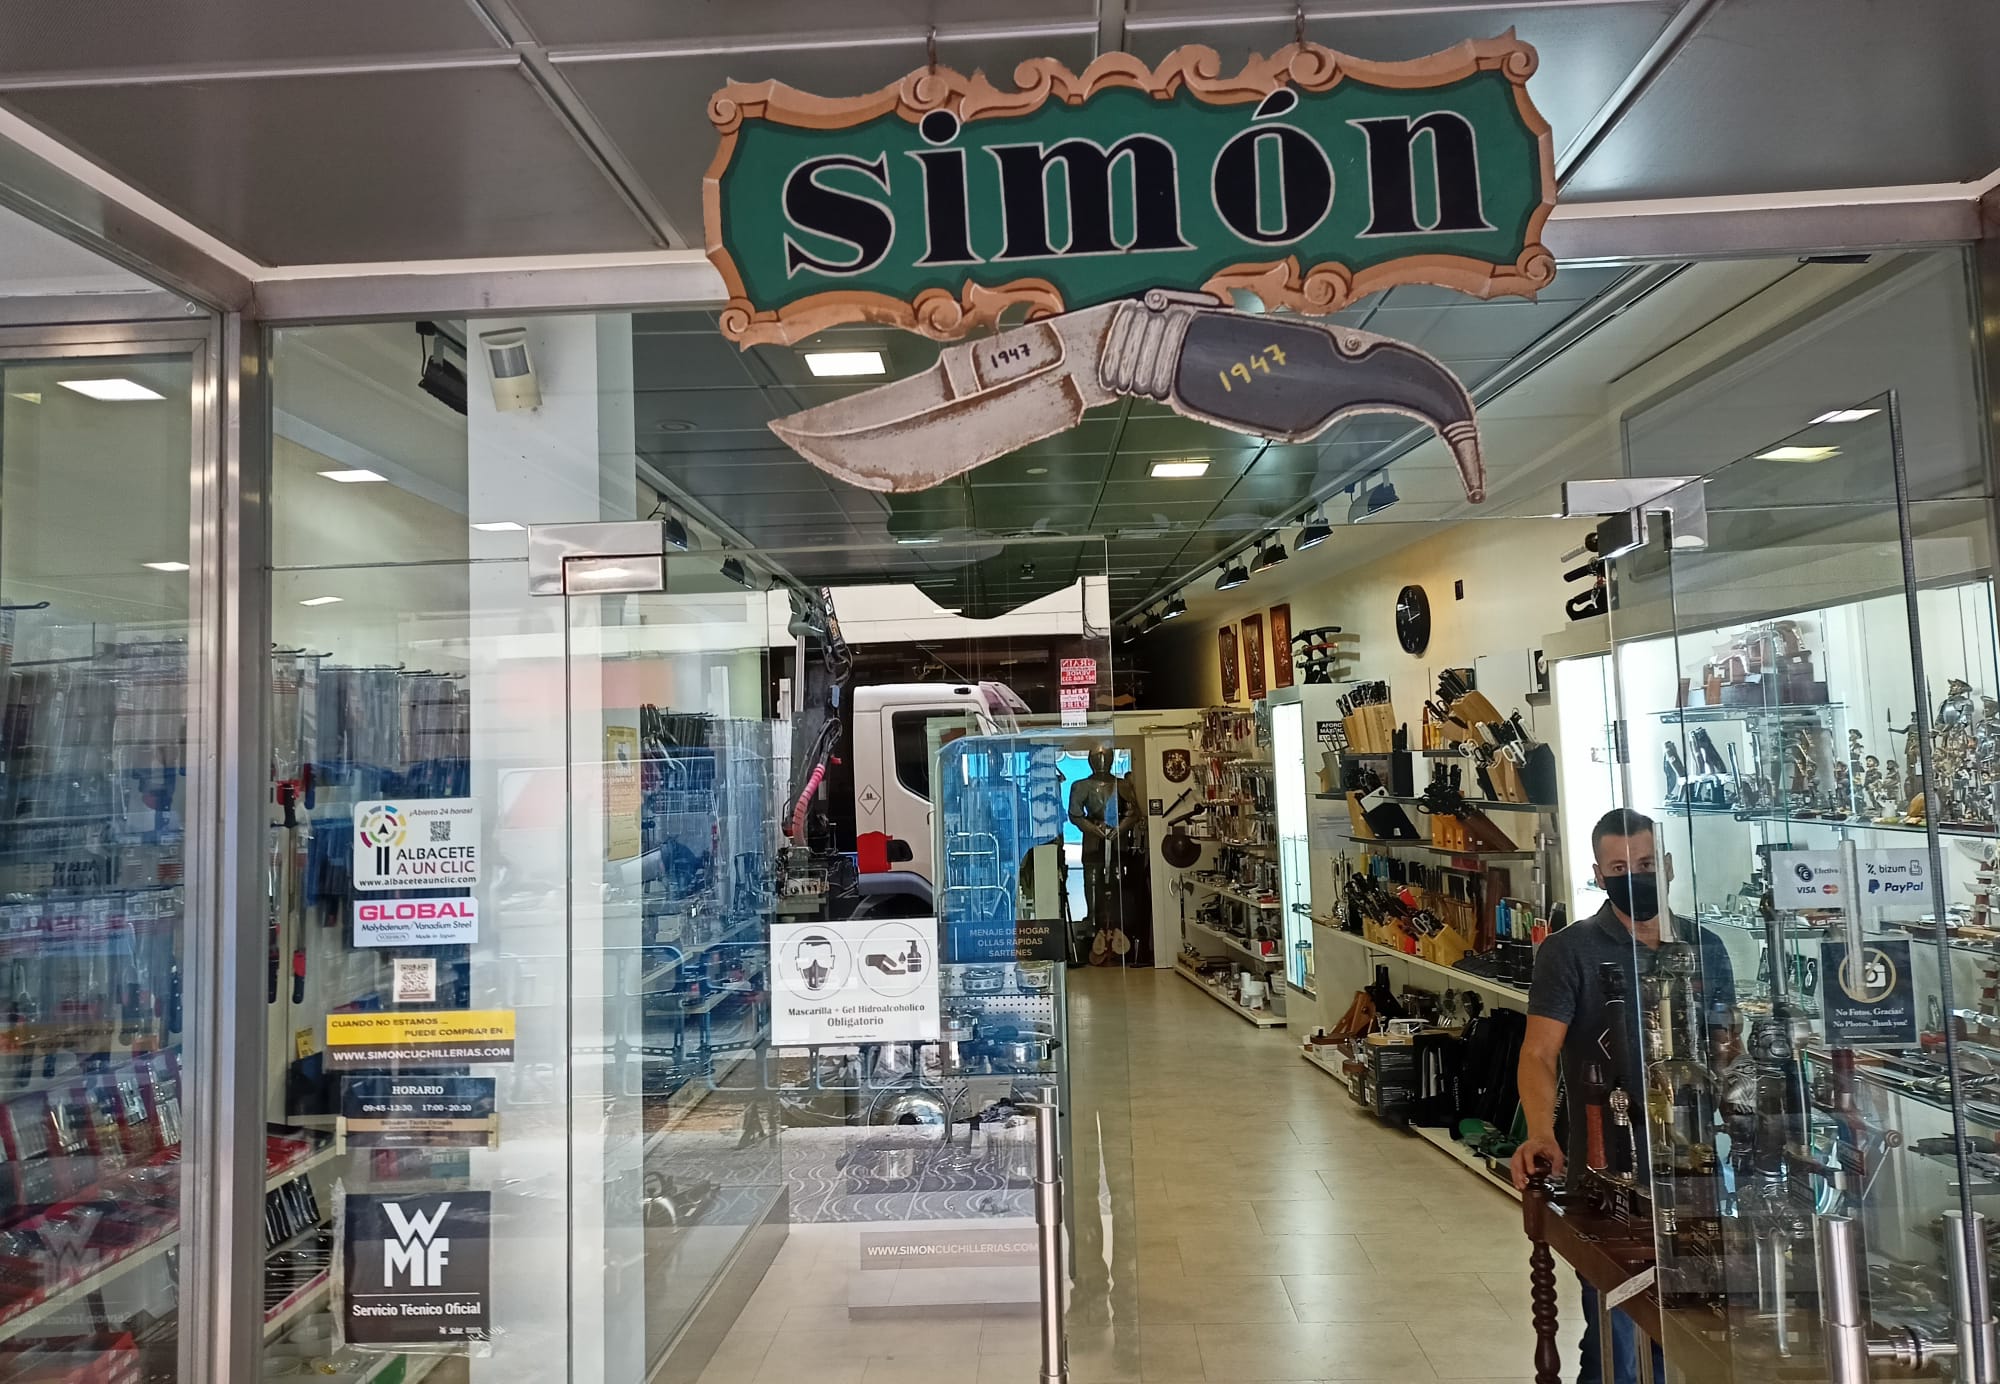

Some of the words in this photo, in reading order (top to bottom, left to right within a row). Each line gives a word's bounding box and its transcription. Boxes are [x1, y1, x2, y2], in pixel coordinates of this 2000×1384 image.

[782, 88, 1498, 279] simón
[989, 342, 1032, 369] 1947
[1218, 343, 1287, 393] 1947
[439, 808, 450, 816] 24
[396, 846, 475, 860] ALBACETE
[396, 864, 408, 875] A
[413, 862, 436, 874] UN
[440, 860, 474, 874] CLIC
[1878, 864, 1906, 874] bizum
[359, 876, 476, 886] www.albaceteaunclic.com
[1796, 886, 1816, 894] VISA
[1884, 882, 1923, 894] PayPal
[359, 902, 474, 920] GLOBAL
[453, 920, 471, 929] Steel
[1005, 928, 1018, 936] DE
[1018, 927, 1050, 935] HOGAR
[978, 939, 1004, 947] OLLAS
[988, 949, 1032, 957] SARTENES
[788, 1007, 832, 1016] Mascarilla
[842, 1005, 856, 1014] Gel
[1835, 1008, 1847, 1016] No
[332, 1019, 374, 1028] CUANDO
[393, 1018, 438, 1026] ESTAMOS
[827, 1016, 884, 1028] Obligatorio
[405, 1029, 437, 1037] PUEDE
[439, 1028, 487, 1036] COMPRAR
[333, 1048, 510, 1061] WWW.SIMONCUCHILLERIAS.COM
[392, 1086, 444, 1095] HORARIO
[382, 1202, 452, 1287] WMF
[868, 1242, 1039, 1256] WWW.SIMONCUCHILLERIAS.COM
[352, 1304, 398, 1316] Servicio
[400, 1302, 442, 1316] Técnico
[445, 1302, 481, 1315] Oficial
